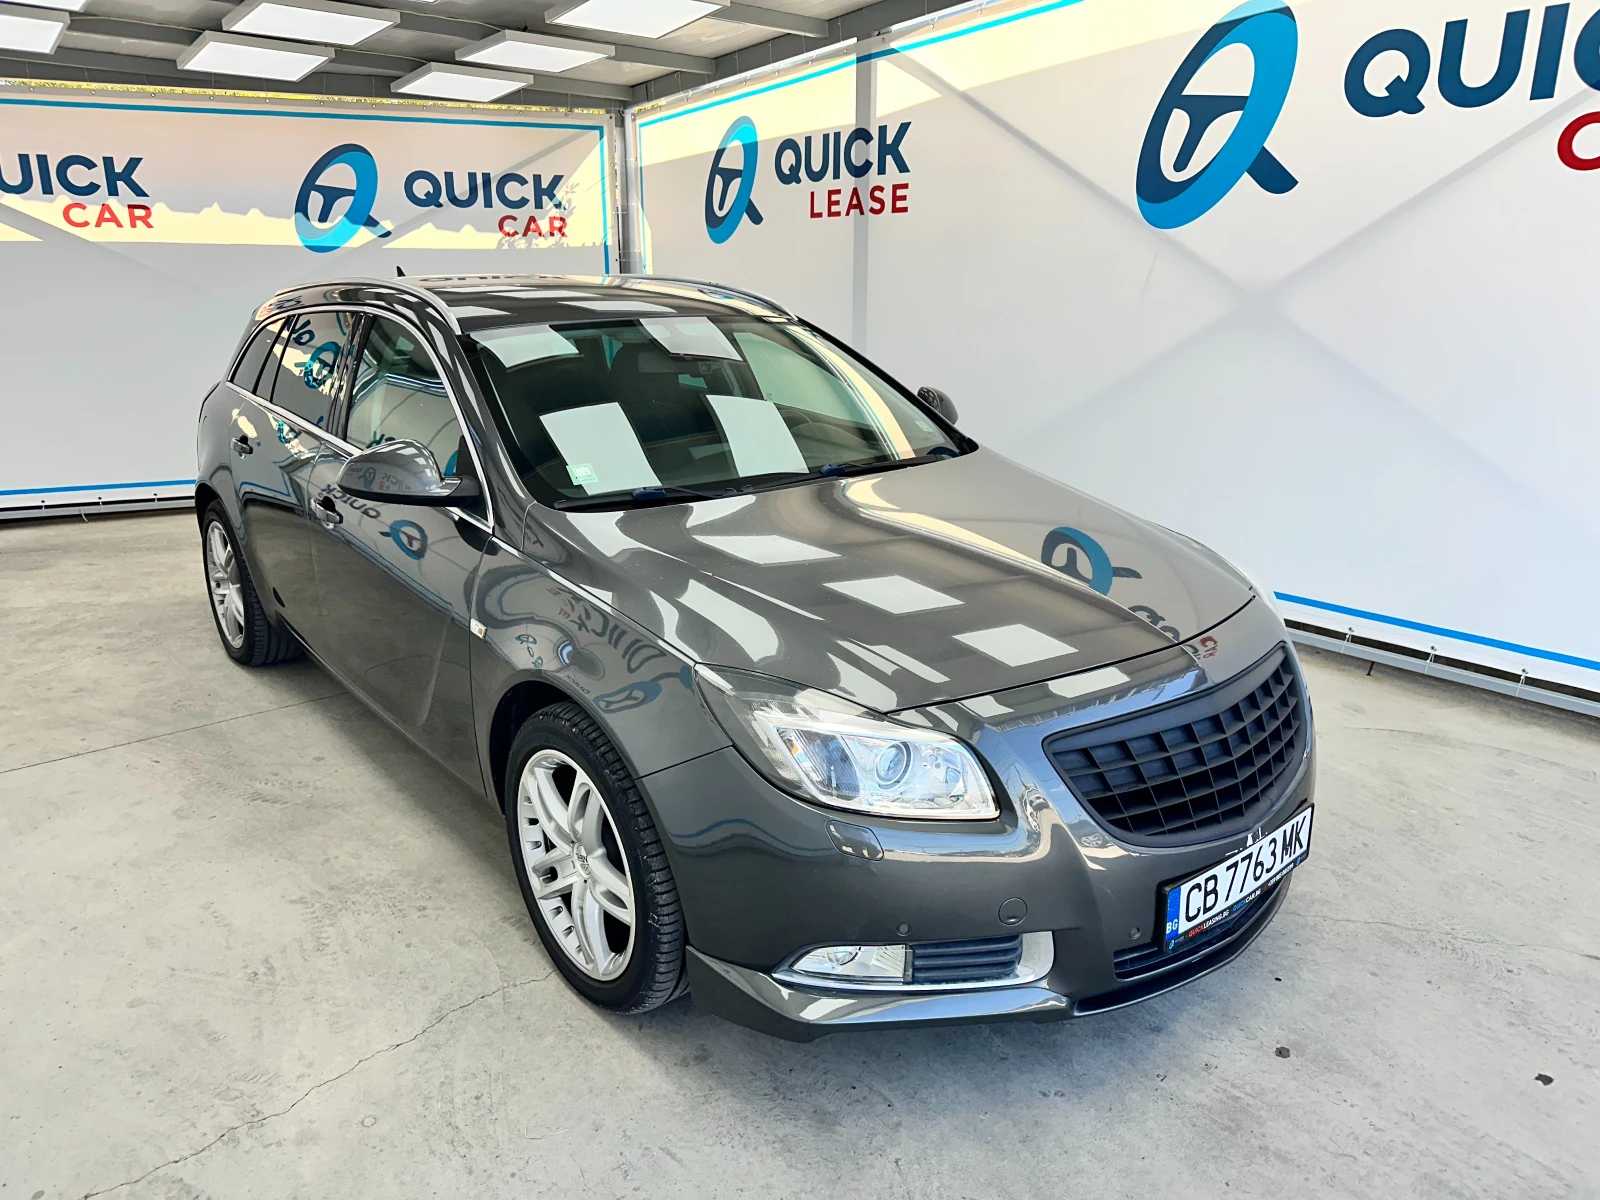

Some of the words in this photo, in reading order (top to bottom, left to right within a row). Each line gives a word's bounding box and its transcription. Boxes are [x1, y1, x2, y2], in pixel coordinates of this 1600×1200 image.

[774, 121, 912, 186] QUICK
[403, 170, 566, 211] QUICK
[809, 182, 911, 219] LEASE
[62, 201, 154, 229] CAR
[498, 213, 568, 238] CAR
[1184, 873, 1219, 924] CB
[1224, 836, 1278, 904] 7763
[1280, 815, 1307, 865] MK
[1166, 918, 1179, 935] BG
